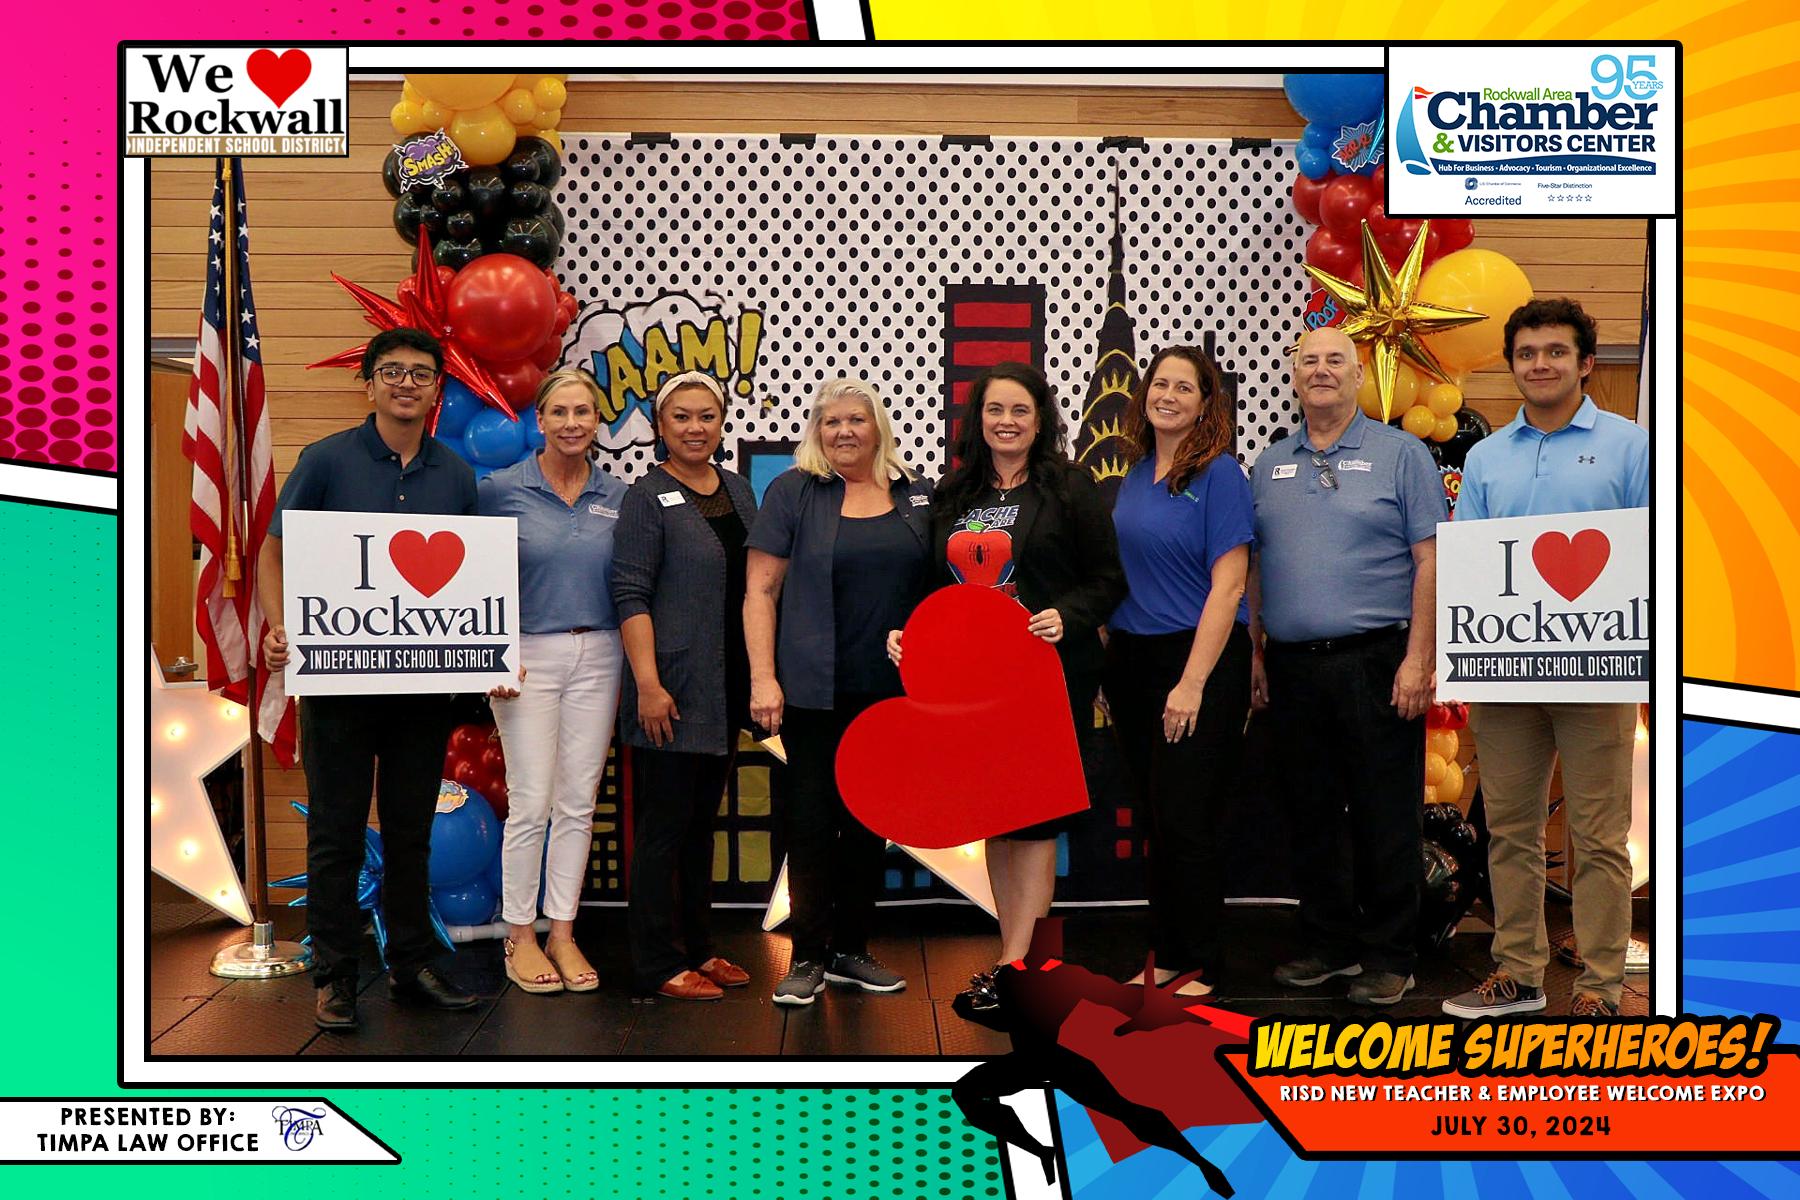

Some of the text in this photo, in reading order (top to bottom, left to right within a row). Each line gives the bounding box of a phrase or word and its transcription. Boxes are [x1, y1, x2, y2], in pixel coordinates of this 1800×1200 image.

[353, 534, 376, 590] I
[1498, 540, 1519, 597] I
[297, 595, 509, 637] Rockwall
[310, 649, 495, 670] INDEPENDENT SCHOOL DISTRICT
[1457, 655, 1643, 677] INDEPENDENT SCHOOL DISTRICT
